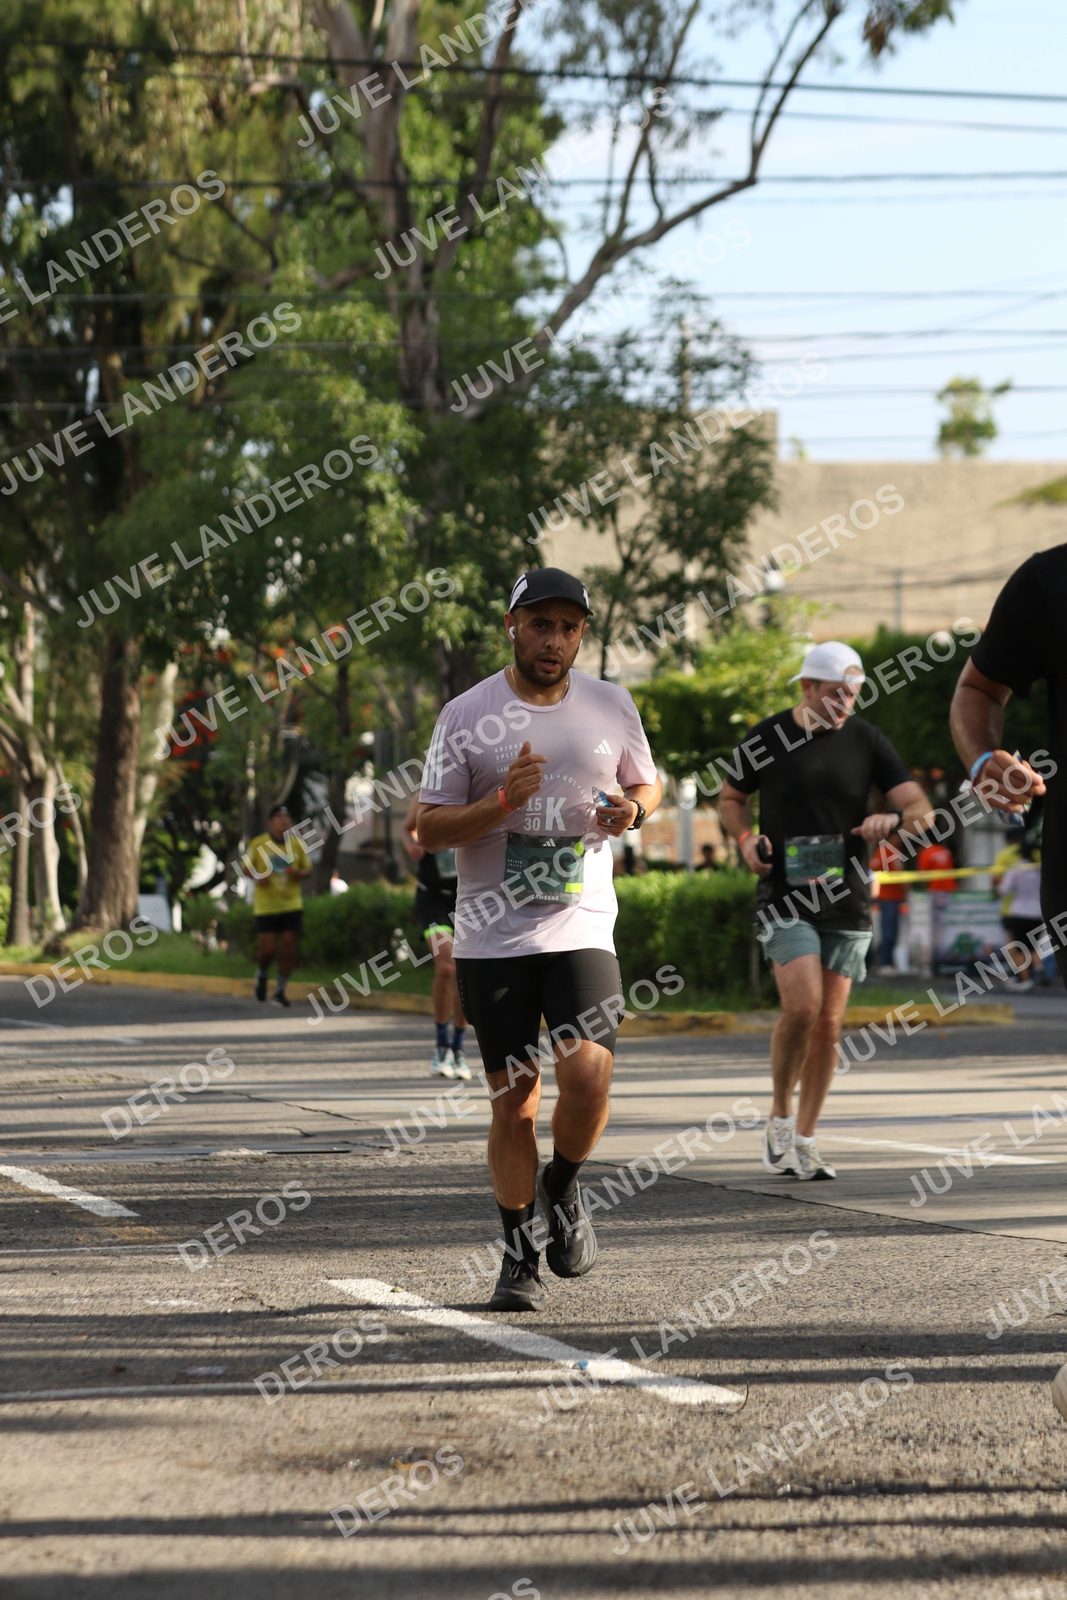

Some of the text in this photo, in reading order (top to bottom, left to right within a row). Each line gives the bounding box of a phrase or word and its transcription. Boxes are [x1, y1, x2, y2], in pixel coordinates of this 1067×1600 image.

[523, 817, 541, 831] 30
[526, 797, 567, 831] 15 K
